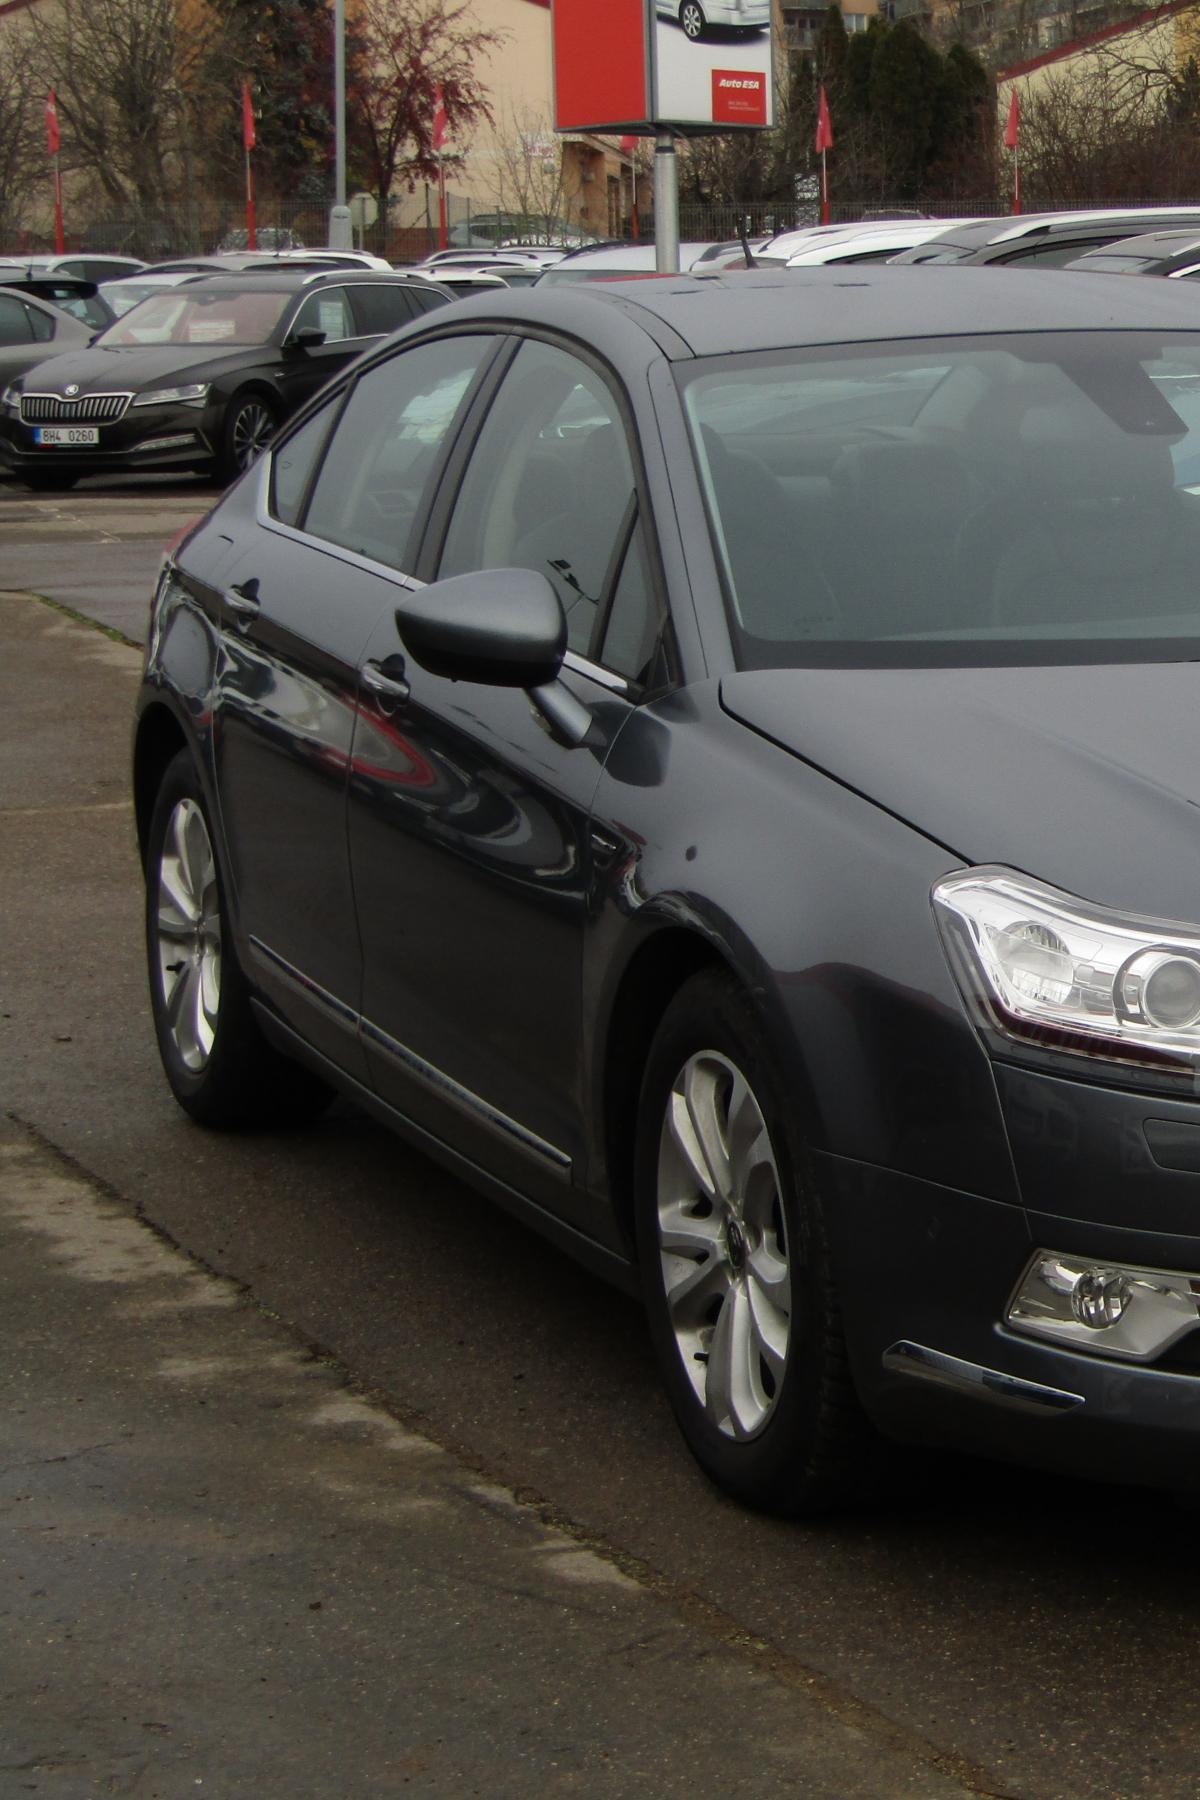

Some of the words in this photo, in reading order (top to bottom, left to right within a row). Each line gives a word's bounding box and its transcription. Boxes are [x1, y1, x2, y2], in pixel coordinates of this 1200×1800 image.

[718, 78, 742, 89] Auto
[742, 80, 760, 90] ESA
[43, 430, 61, 443] 8H4
[68, 430, 94, 442] 0260
